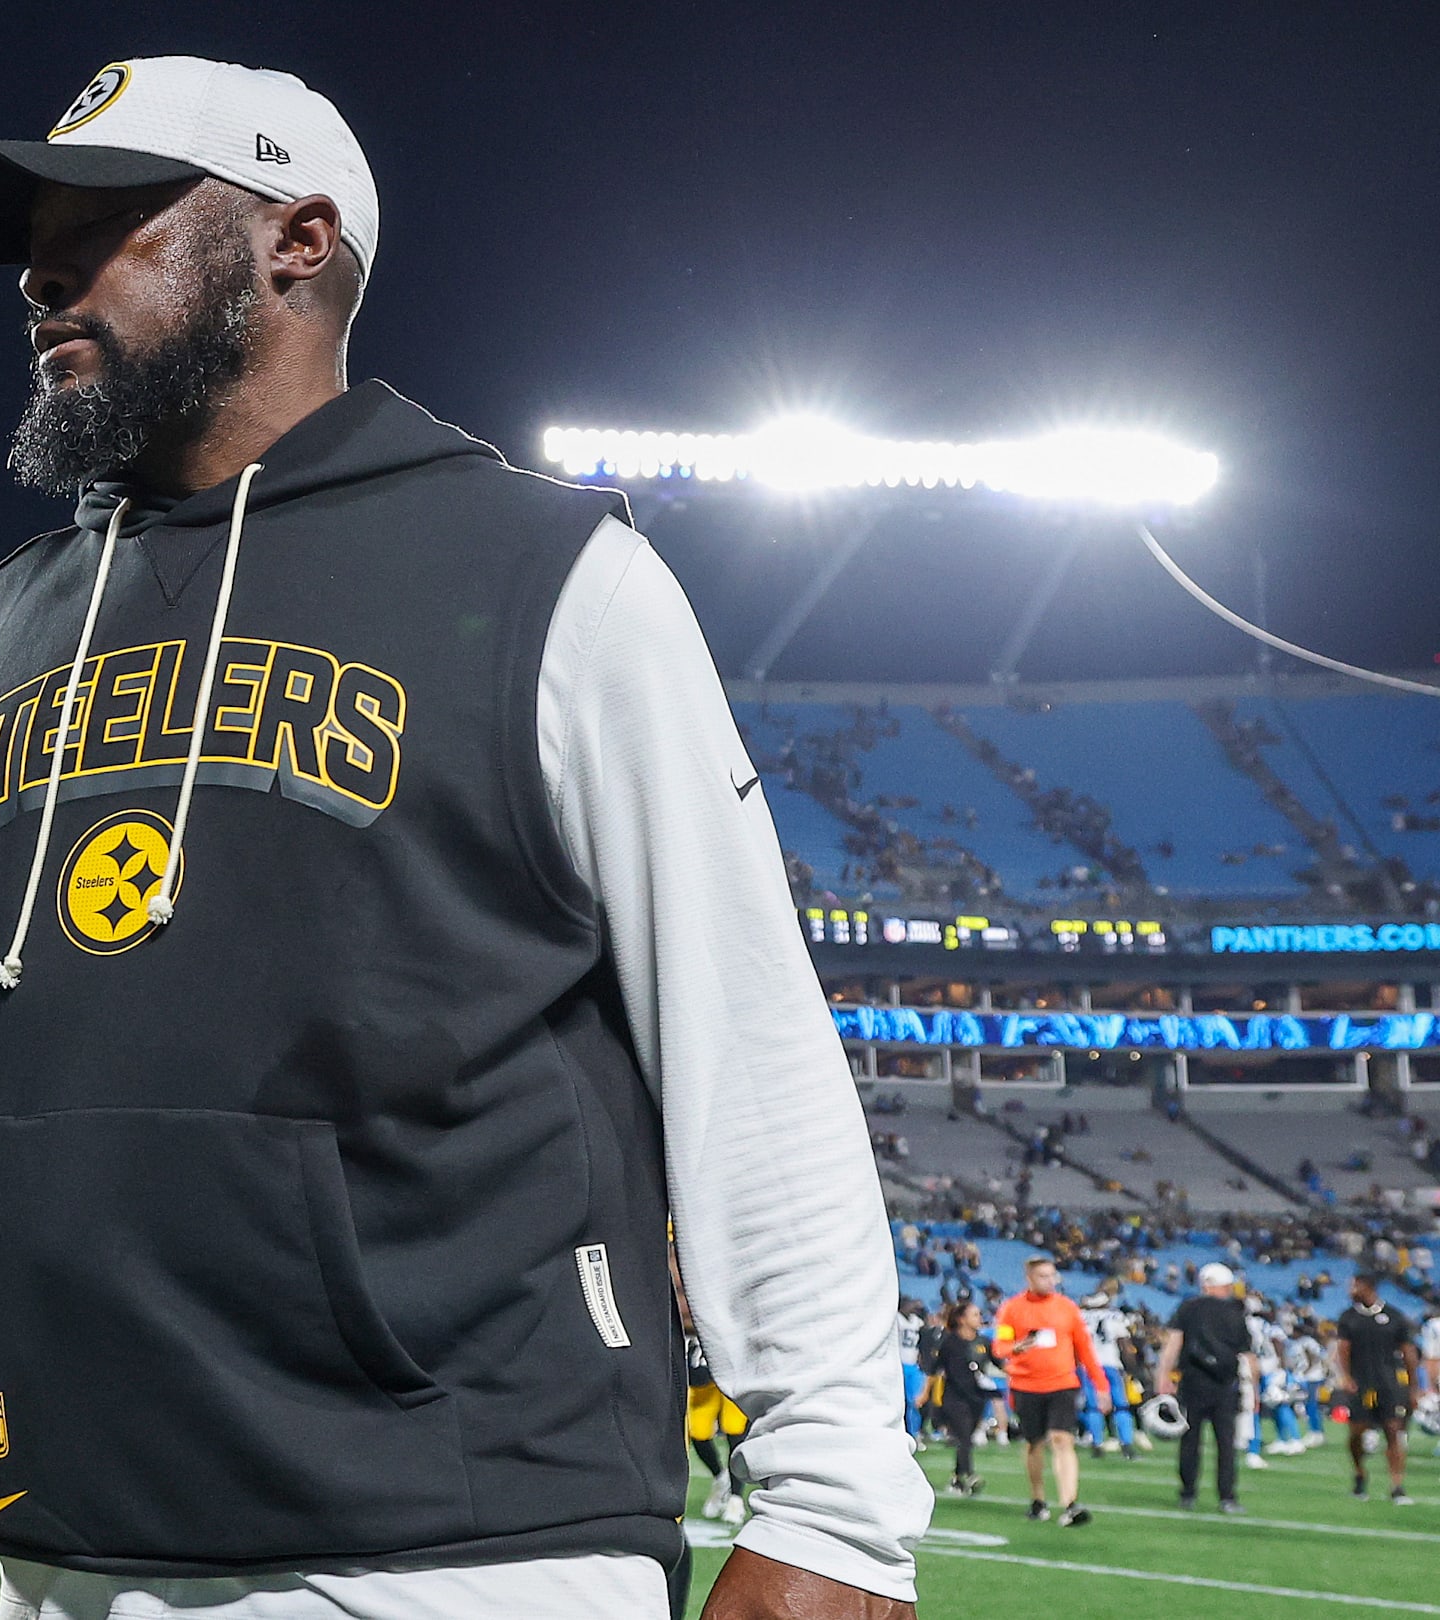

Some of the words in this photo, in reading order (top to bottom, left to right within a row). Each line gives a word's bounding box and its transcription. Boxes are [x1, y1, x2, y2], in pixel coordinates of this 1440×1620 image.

[76, 875, 114, 889] Steelers
[593, 1265, 603, 1287] ISSUE
[597, 1287, 612, 1323] STANDARD
